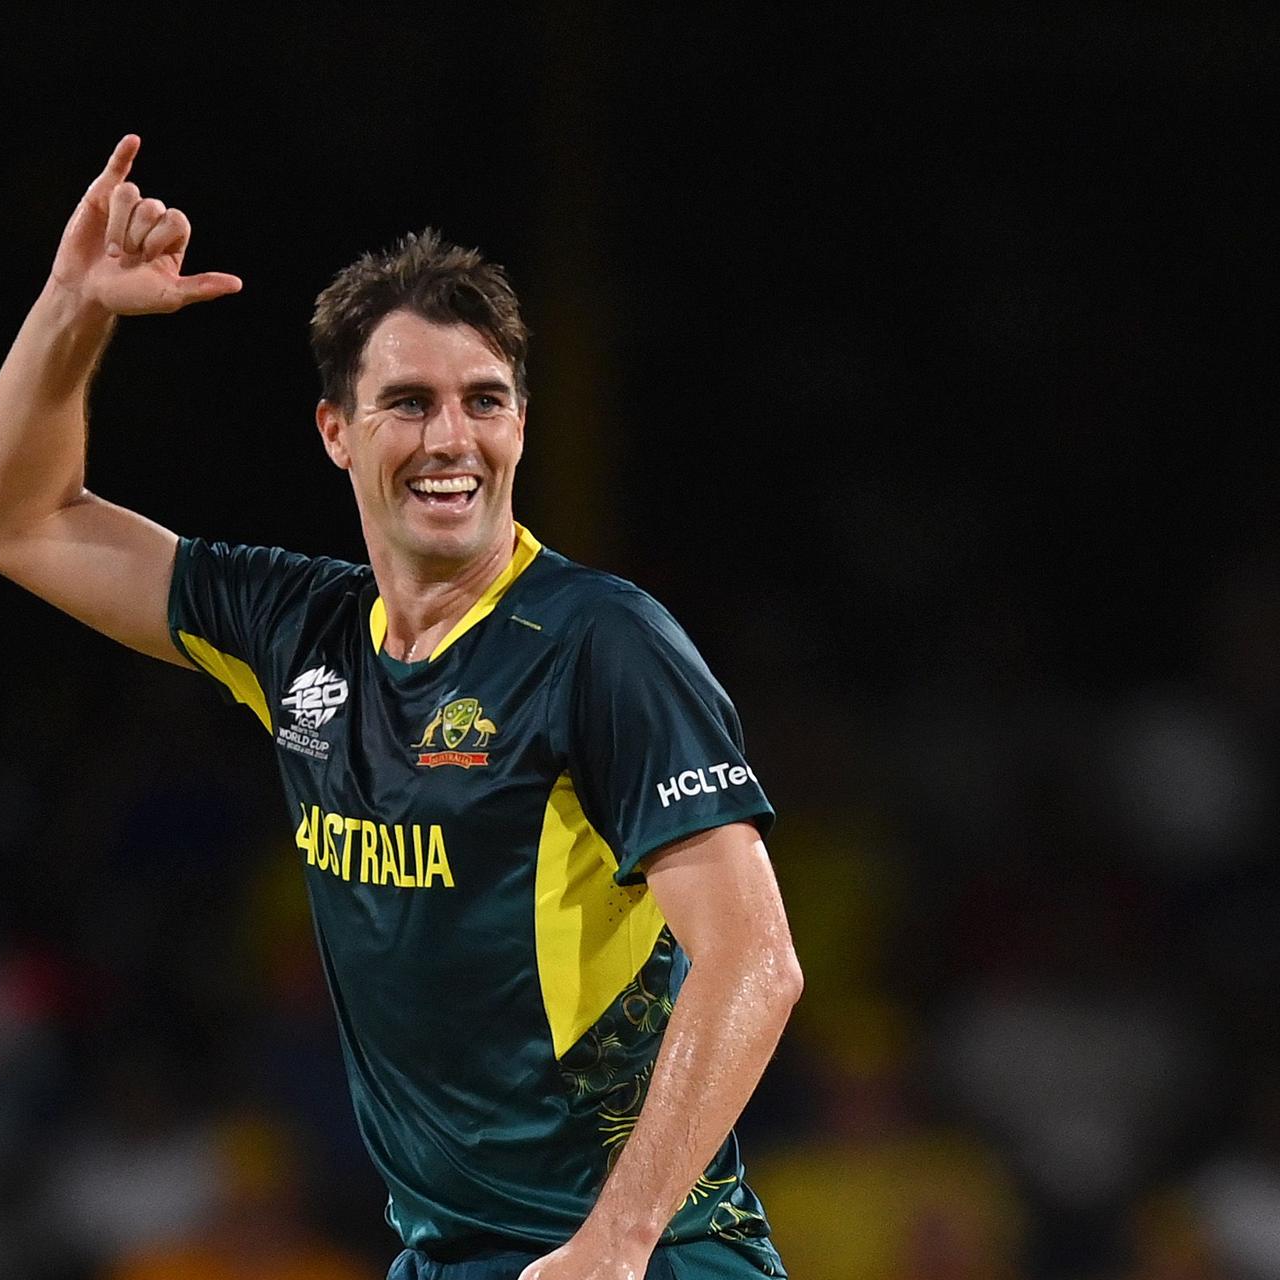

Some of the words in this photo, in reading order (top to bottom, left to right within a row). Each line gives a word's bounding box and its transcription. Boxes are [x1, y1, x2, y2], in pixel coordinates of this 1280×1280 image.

[279, 727, 310, 746] WORLD
[309, 740, 330, 752] CUP
[295, 802, 456, 888] AUSTRALIA
